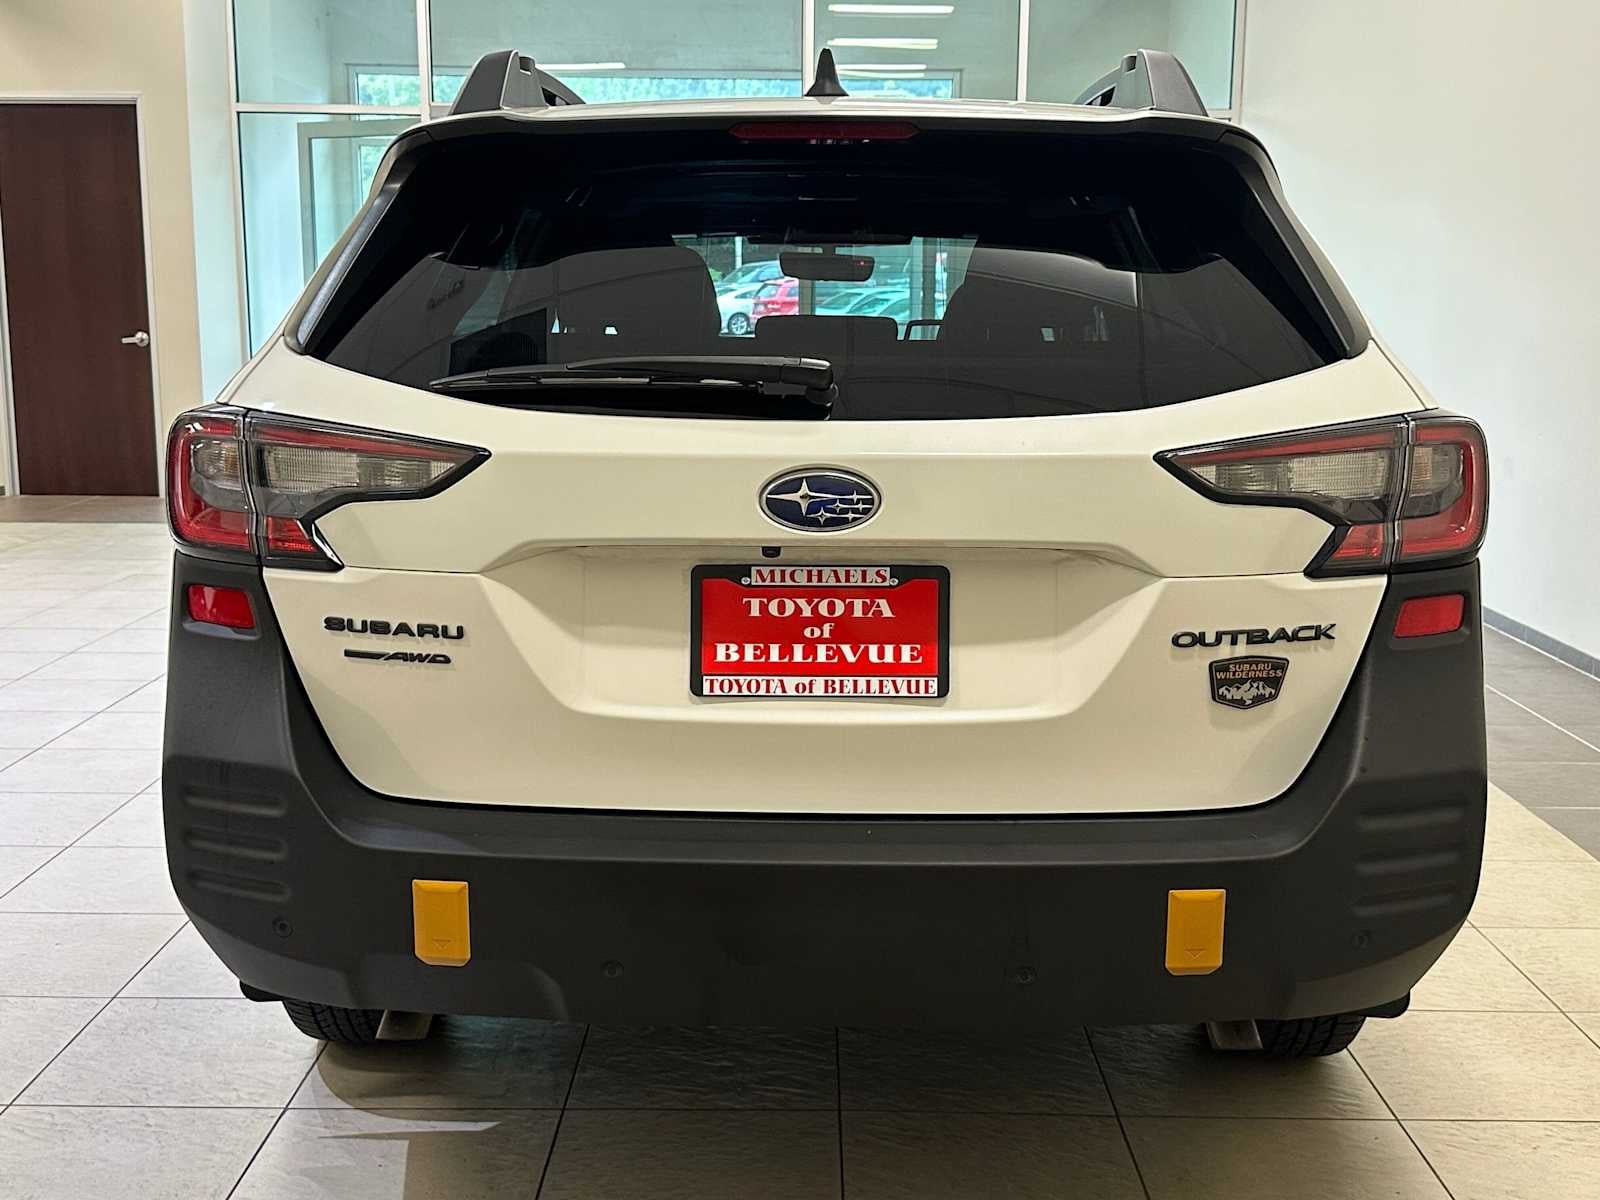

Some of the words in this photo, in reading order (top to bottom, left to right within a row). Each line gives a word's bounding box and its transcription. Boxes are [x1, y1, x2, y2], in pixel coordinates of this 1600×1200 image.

[754, 568, 888, 584] MICHAELS
[743, 597, 896, 618] TOYOTA
[324, 616, 465, 640] SUBARU
[803, 622, 835, 639] of
[1171, 623, 1337, 648] OUTBACK
[383, 651, 452, 664] AWD
[714, 643, 923, 664] BELLEVUE
[1216, 669, 1283, 680] WILDERNESS
[1229, 662, 1272, 672] SUBARU
[704, 677, 787, 694] TOYOTA
[794, 678, 817, 694] of
[823, 678, 936, 695] BELLEVUE
